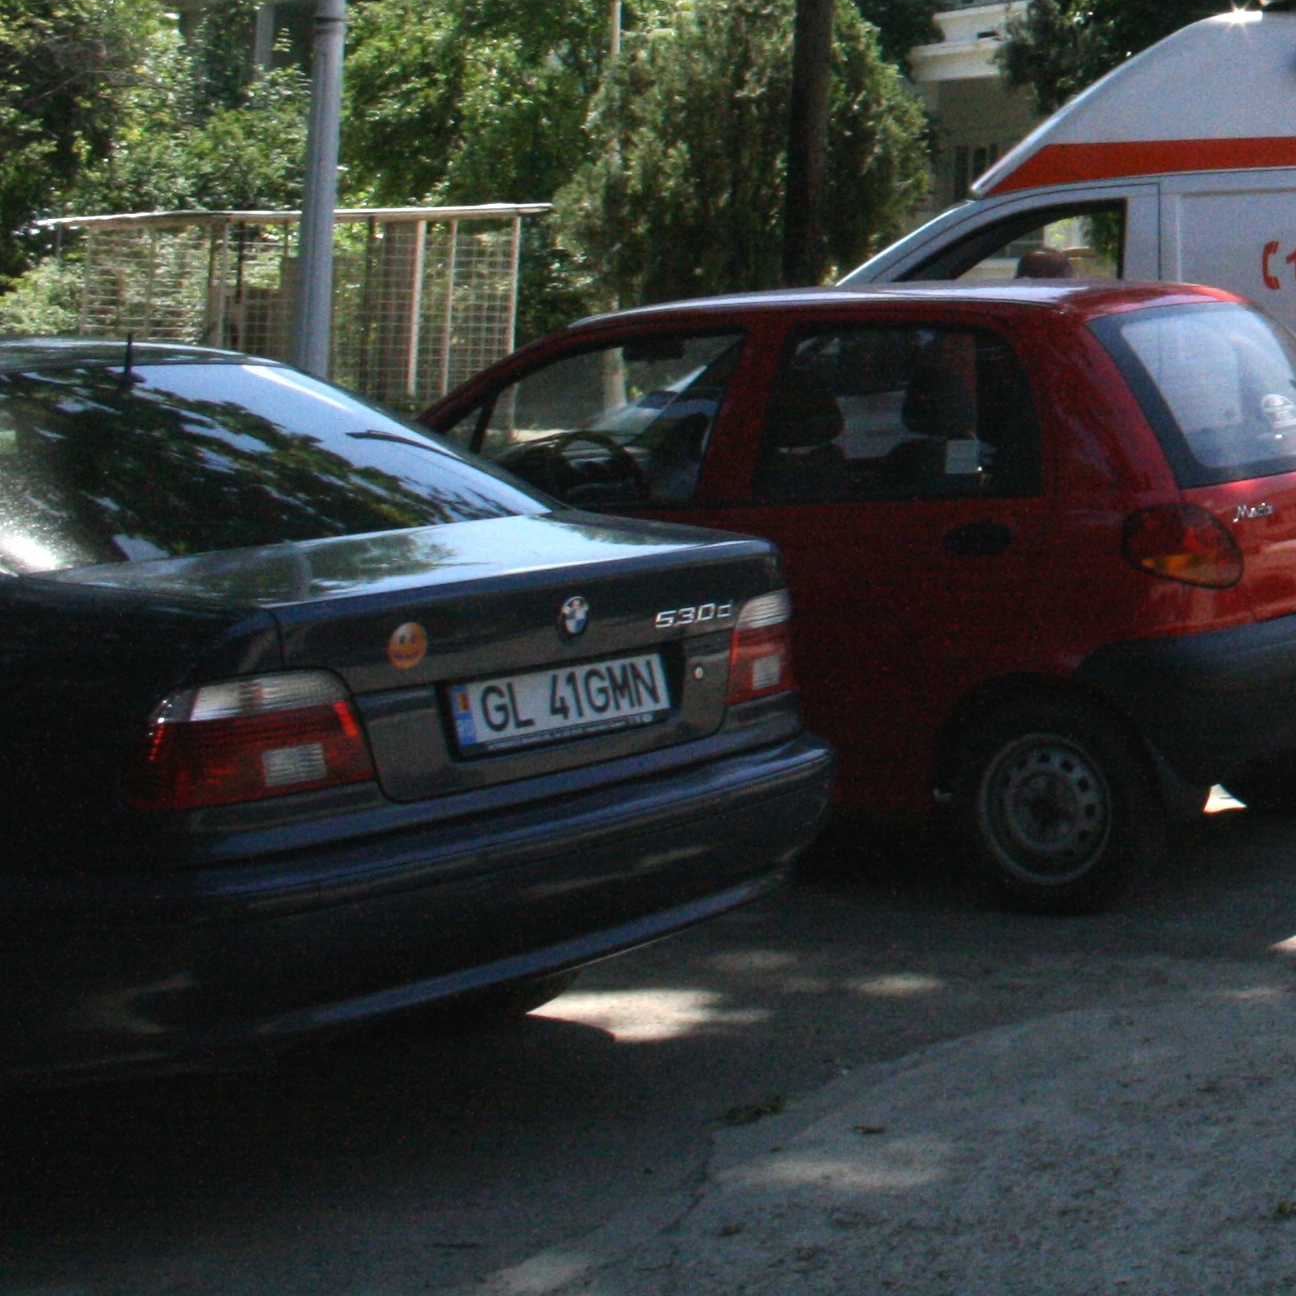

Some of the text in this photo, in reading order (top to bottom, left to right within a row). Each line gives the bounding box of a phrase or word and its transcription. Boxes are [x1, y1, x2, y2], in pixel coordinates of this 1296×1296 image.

[655, 600, 734, 628] 530d
[481, 682, 535, 732] GL
[550, 660, 661, 720] 41GMN
